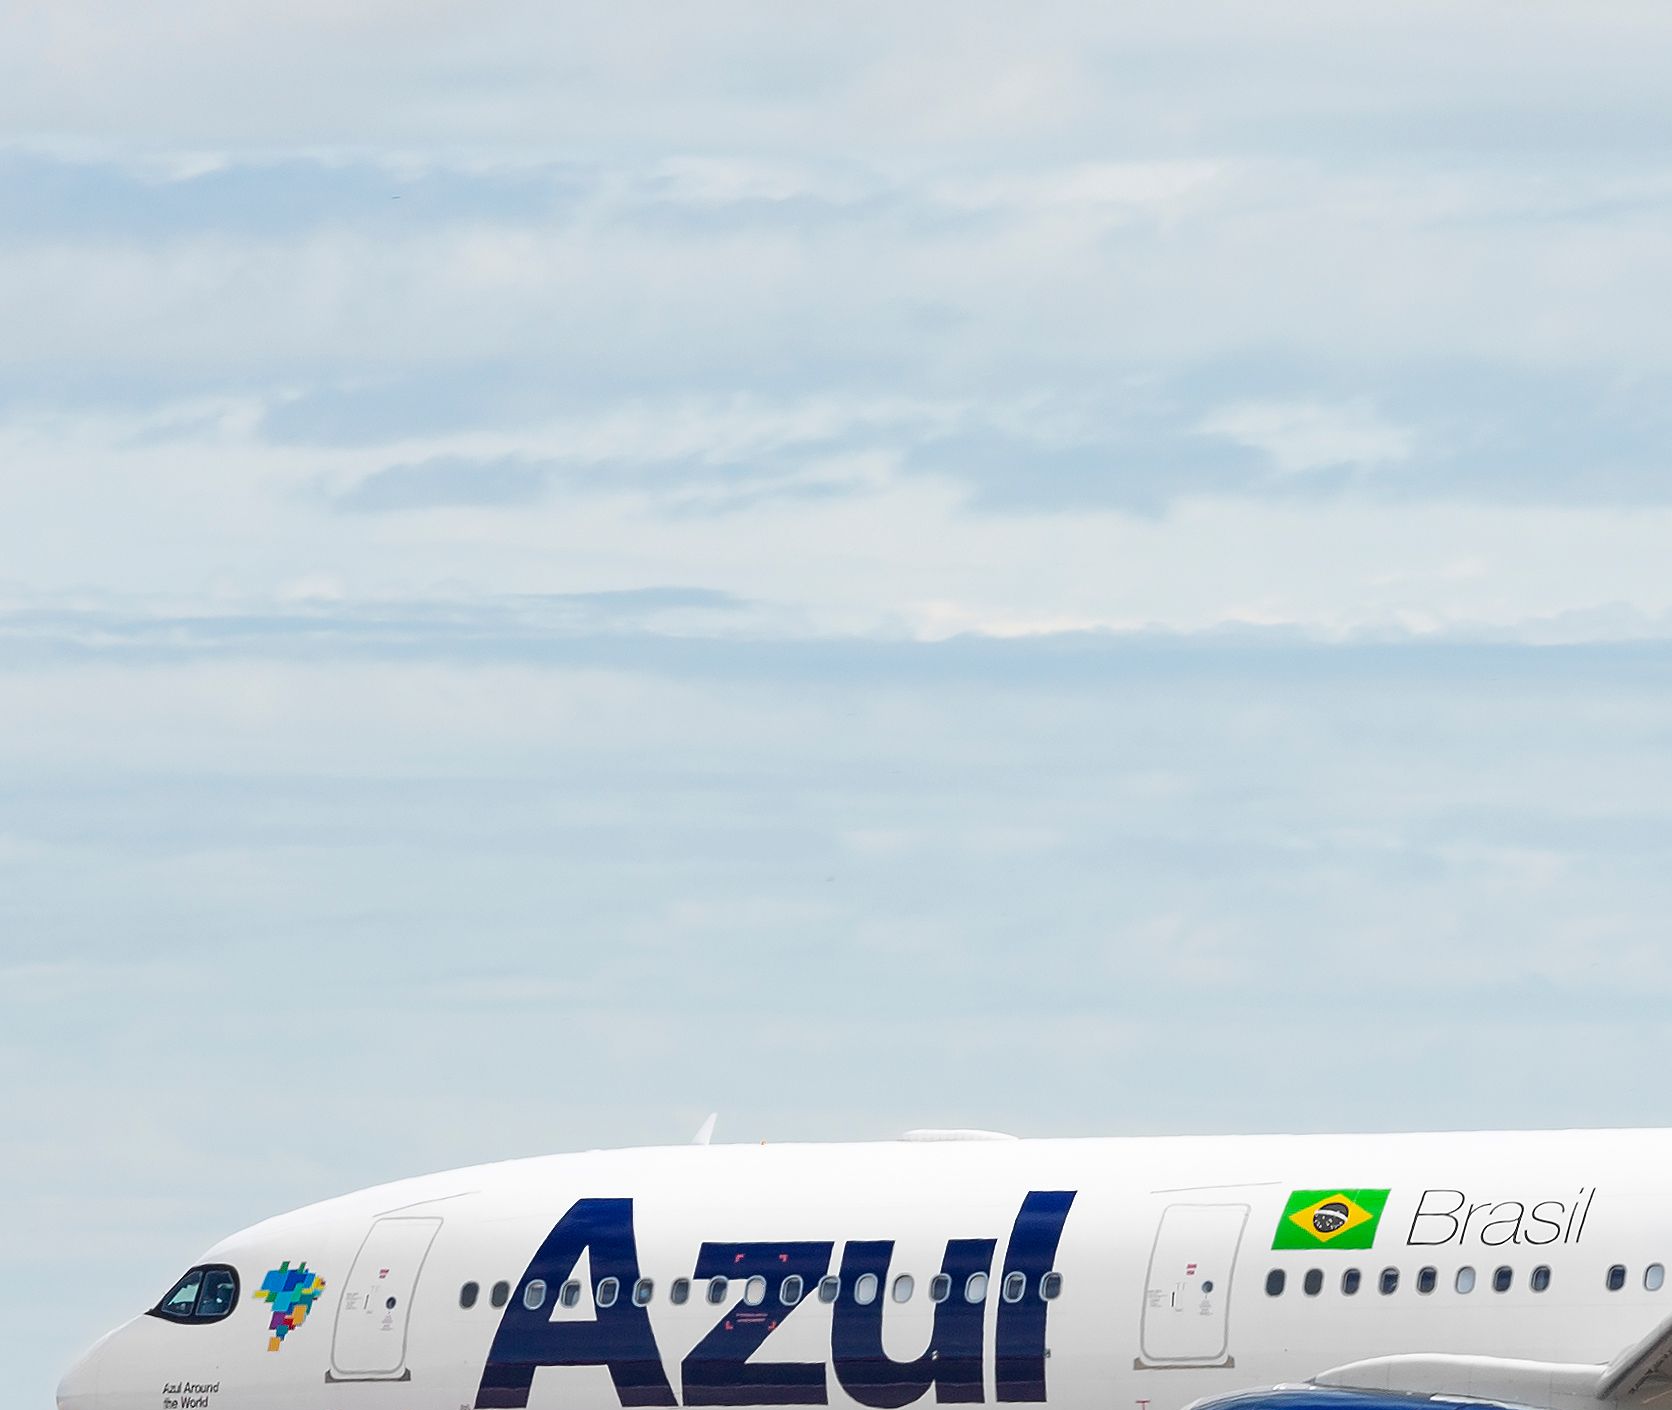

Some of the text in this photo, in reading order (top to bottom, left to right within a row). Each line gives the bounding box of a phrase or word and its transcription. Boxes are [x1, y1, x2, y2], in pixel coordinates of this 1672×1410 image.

[1406, 1187, 1596, 1246] Brasil
[474, 1190, 1078, 1409] Azul
[183, 1381, 220, 1394] Around
